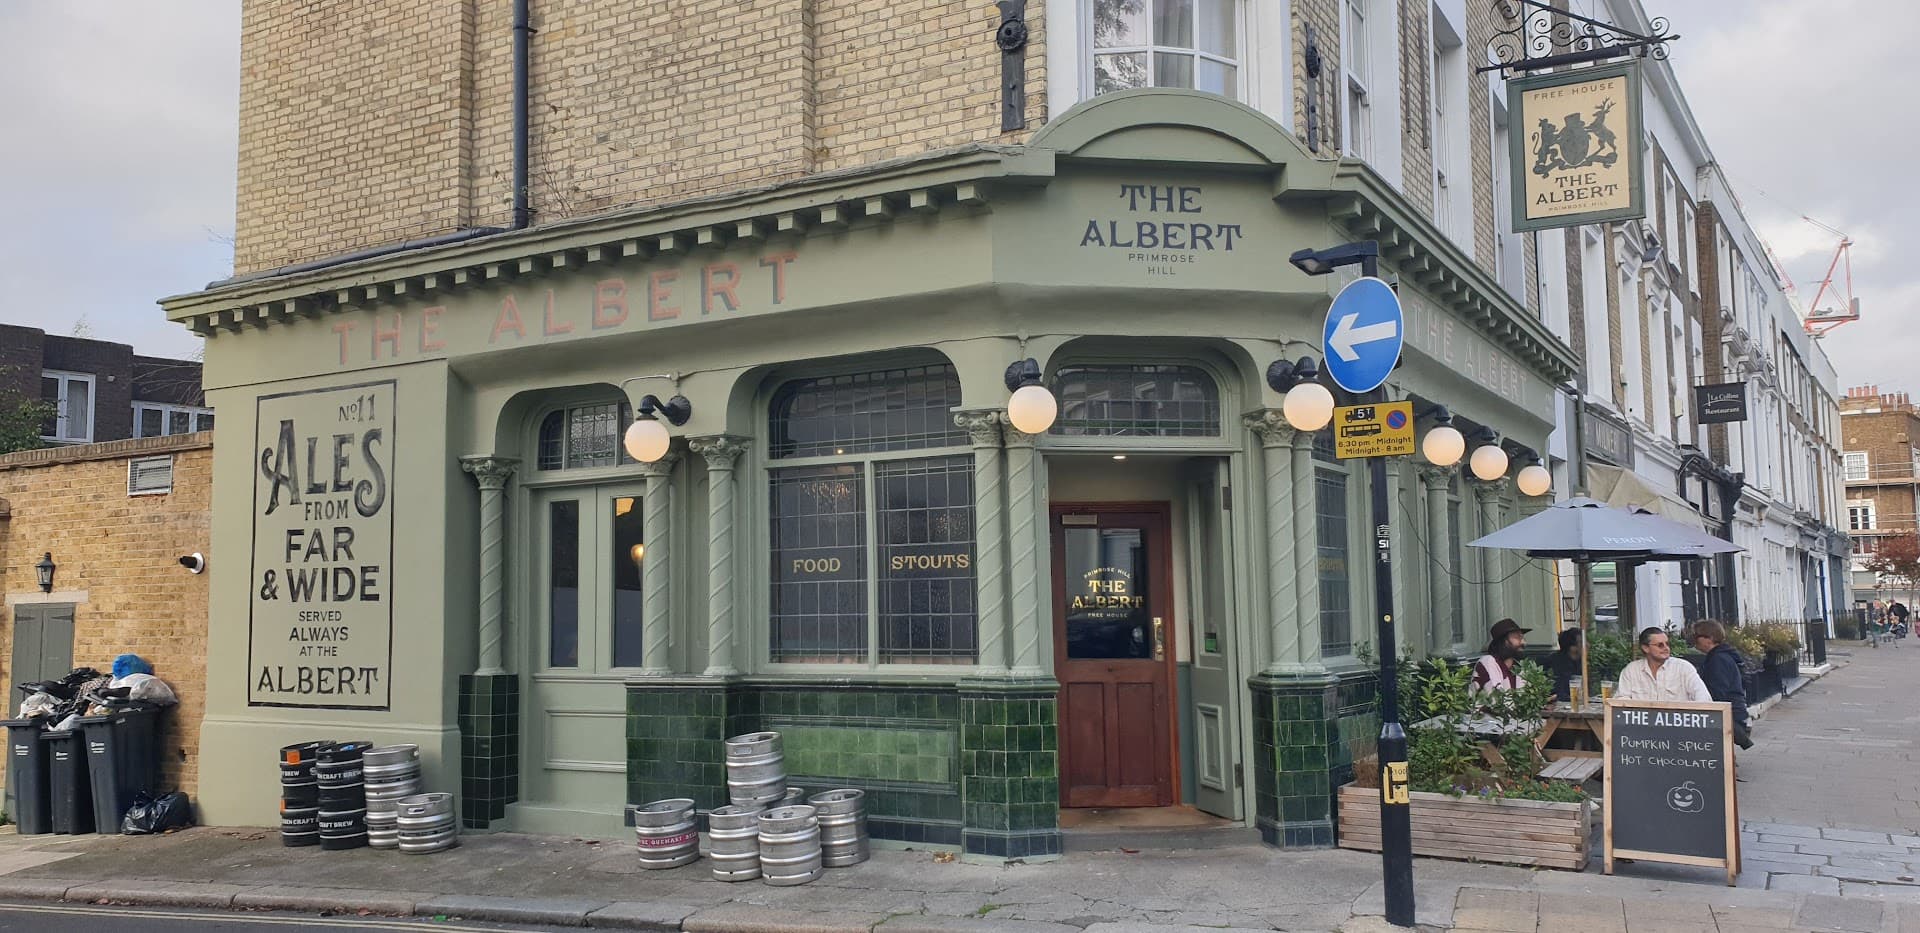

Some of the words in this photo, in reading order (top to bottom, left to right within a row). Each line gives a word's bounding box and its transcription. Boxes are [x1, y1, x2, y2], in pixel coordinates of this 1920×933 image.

[1534, 91, 1564, 101] FREE
[1572, 82, 1614, 95] HOUSE
[1555, 173, 1597, 187] THE
[1120, 184, 1202, 213] THE
[1536, 184, 1618, 205] ALBERT
[1080, 220, 1243, 251] ALBERT
[1128, 253, 1195, 263] PRIMROSE
[1148, 266, 1176, 275] HILL
[331, 305, 447, 367] THE
[488, 252, 799, 345] ALBERT
[1411, 300, 1455, 364] THE
[1464, 335, 1527, 406] ALBERT
[1376, 436, 1412, 446] Midnight
[1346, 446, 1380, 456] Midnight
[261, 419, 386, 517] ALES
[305, 499, 349, 521] FROM
[286, 526, 355, 563] FAR
[1602, 535, 1658, 546] PERONI
[793, 557, 841, 574] FOOD
[892, 553, 970, 570] STOUTS
[260, 569, 279, 600] &
[286, 565, 380, 603] WIDE
[1088, 580, 1126, 593] THE
[1072, 595, 1143, 609] ALBERT
[299, 611, 342, 622] SERVED
[289, 627, 349, 642] ALWAYS
[299, 646, 313, 657] AT
[317, 646, 338, 657] THE
[257, 665, 379, 695] ALBERT
[1622, 711, 1649, 726] THE
[1655, 712, 1709, 728] ALBERT
[1620, 735, 1670, 751] PUMPKIN
[1678, 741, 1714, 753] SPICE
[1620, 754, 1643, 766] HOT
[1649, 756, 1719, 770] CHOCOLATE
